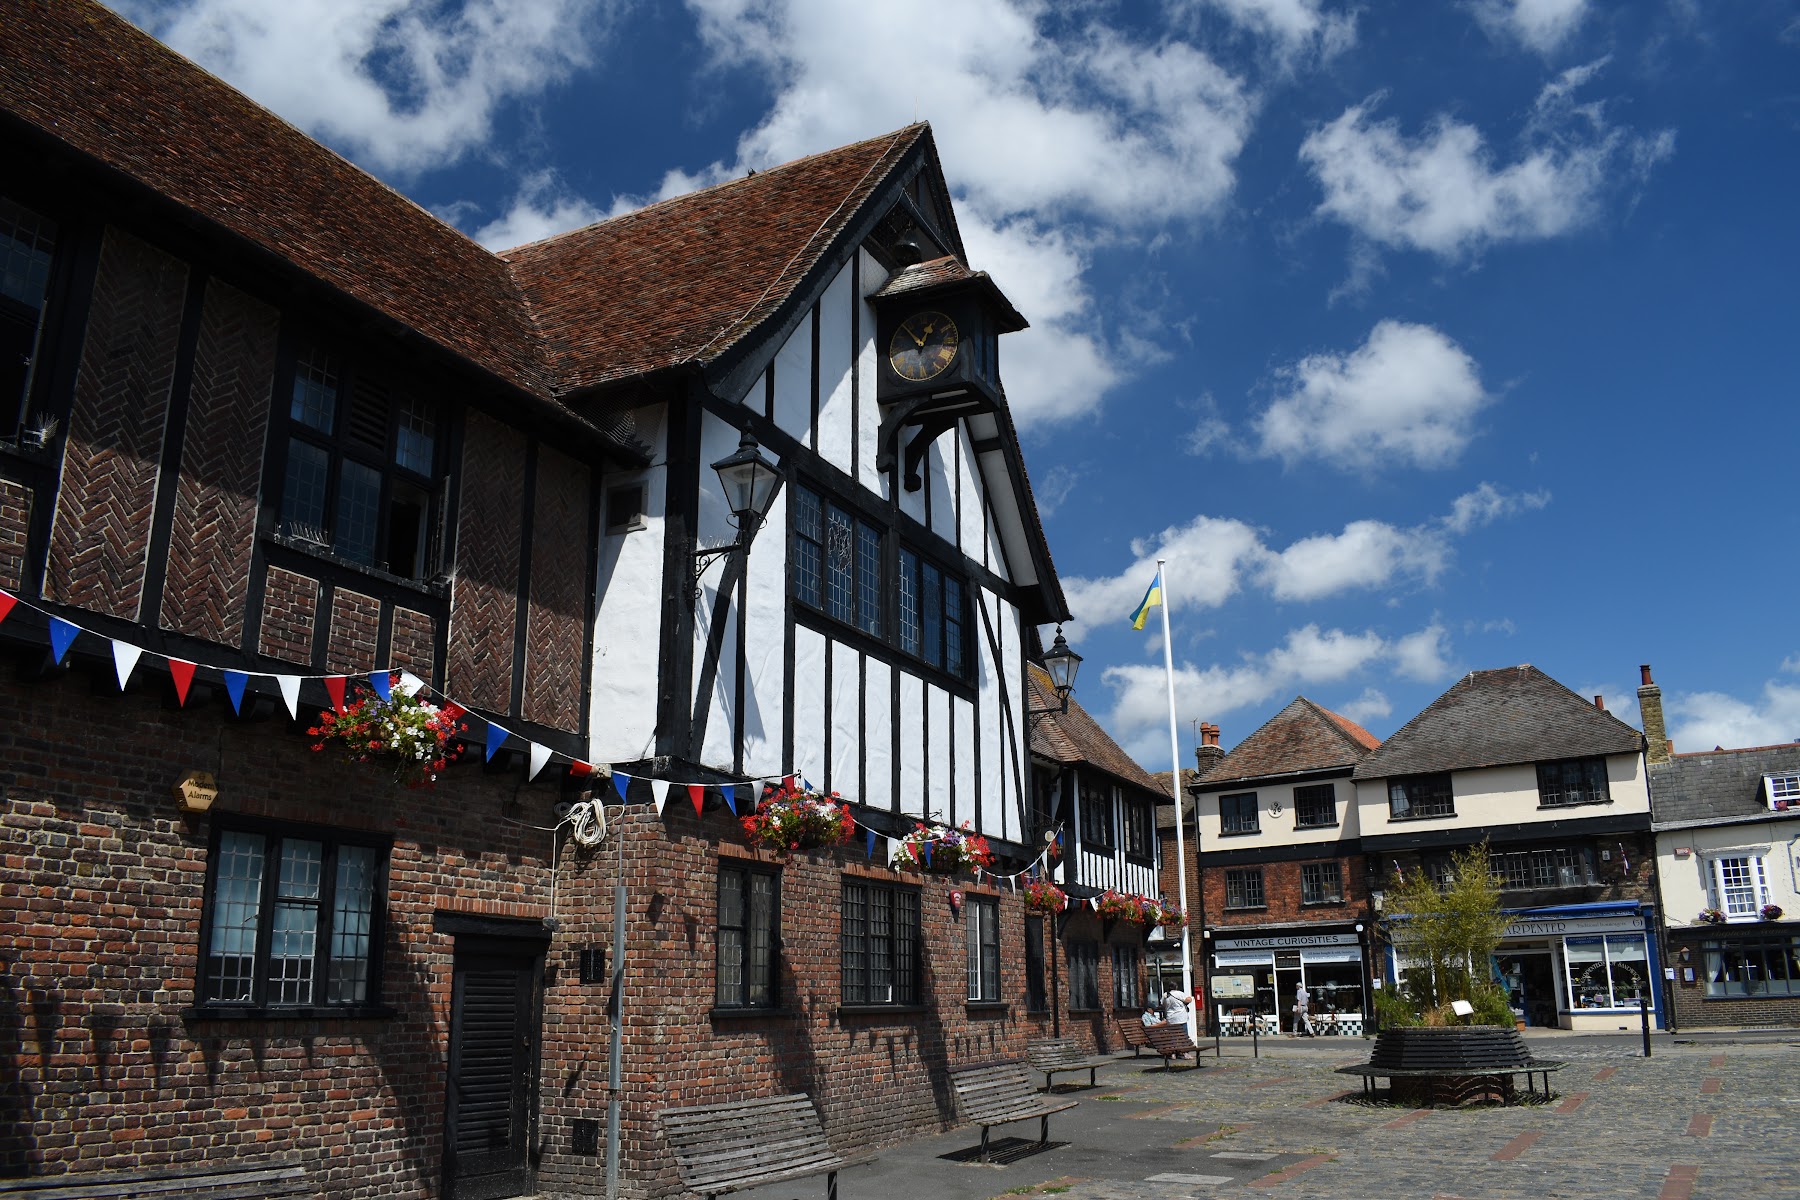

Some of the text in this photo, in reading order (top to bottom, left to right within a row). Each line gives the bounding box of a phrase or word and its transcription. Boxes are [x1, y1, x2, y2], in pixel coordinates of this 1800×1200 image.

[187, 780, 215, 790] Modern
[187, 790, 212, 801] Alarms
[1504, 922, 1567, 935] ARPENTER
[1233, 938, 1275, 947] VINTAGE
[1277, 935, 1339, 945] CURIOSITIES
